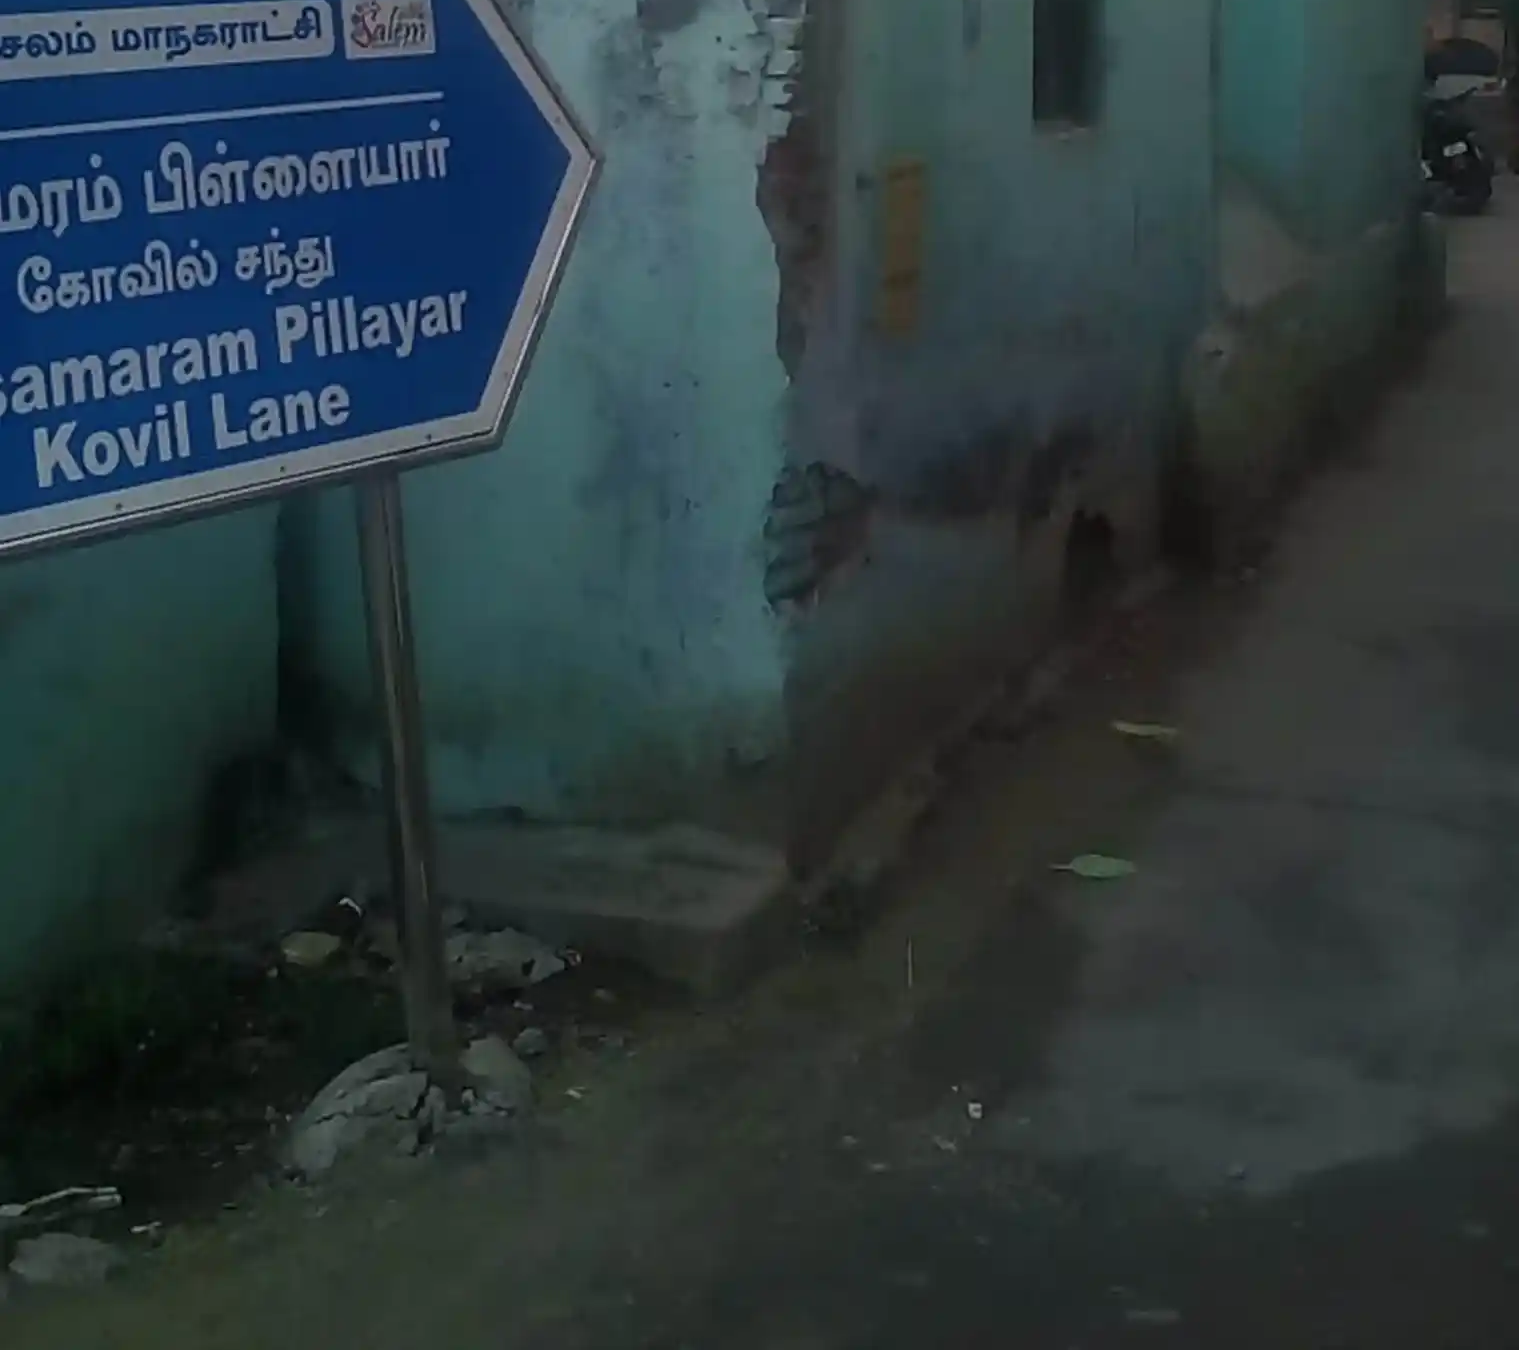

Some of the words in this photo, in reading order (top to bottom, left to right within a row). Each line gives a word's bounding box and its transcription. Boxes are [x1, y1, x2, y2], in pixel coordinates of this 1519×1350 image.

[111, 6, 324, 61] மாநகராட்சி
[351, 0, 426, 48] Salem
[144, 118, 450, 214] பிள்ளையார்
[17, 238, 218, 313] கோவில்
[235, 227, 335, 295] சந்து
[0, 328, 258, 417] amaram
[275, 290, 467, 364] Pillayar
[33, 400, 190, 488] Kovil
[211, 383, 350, 450] Lane
